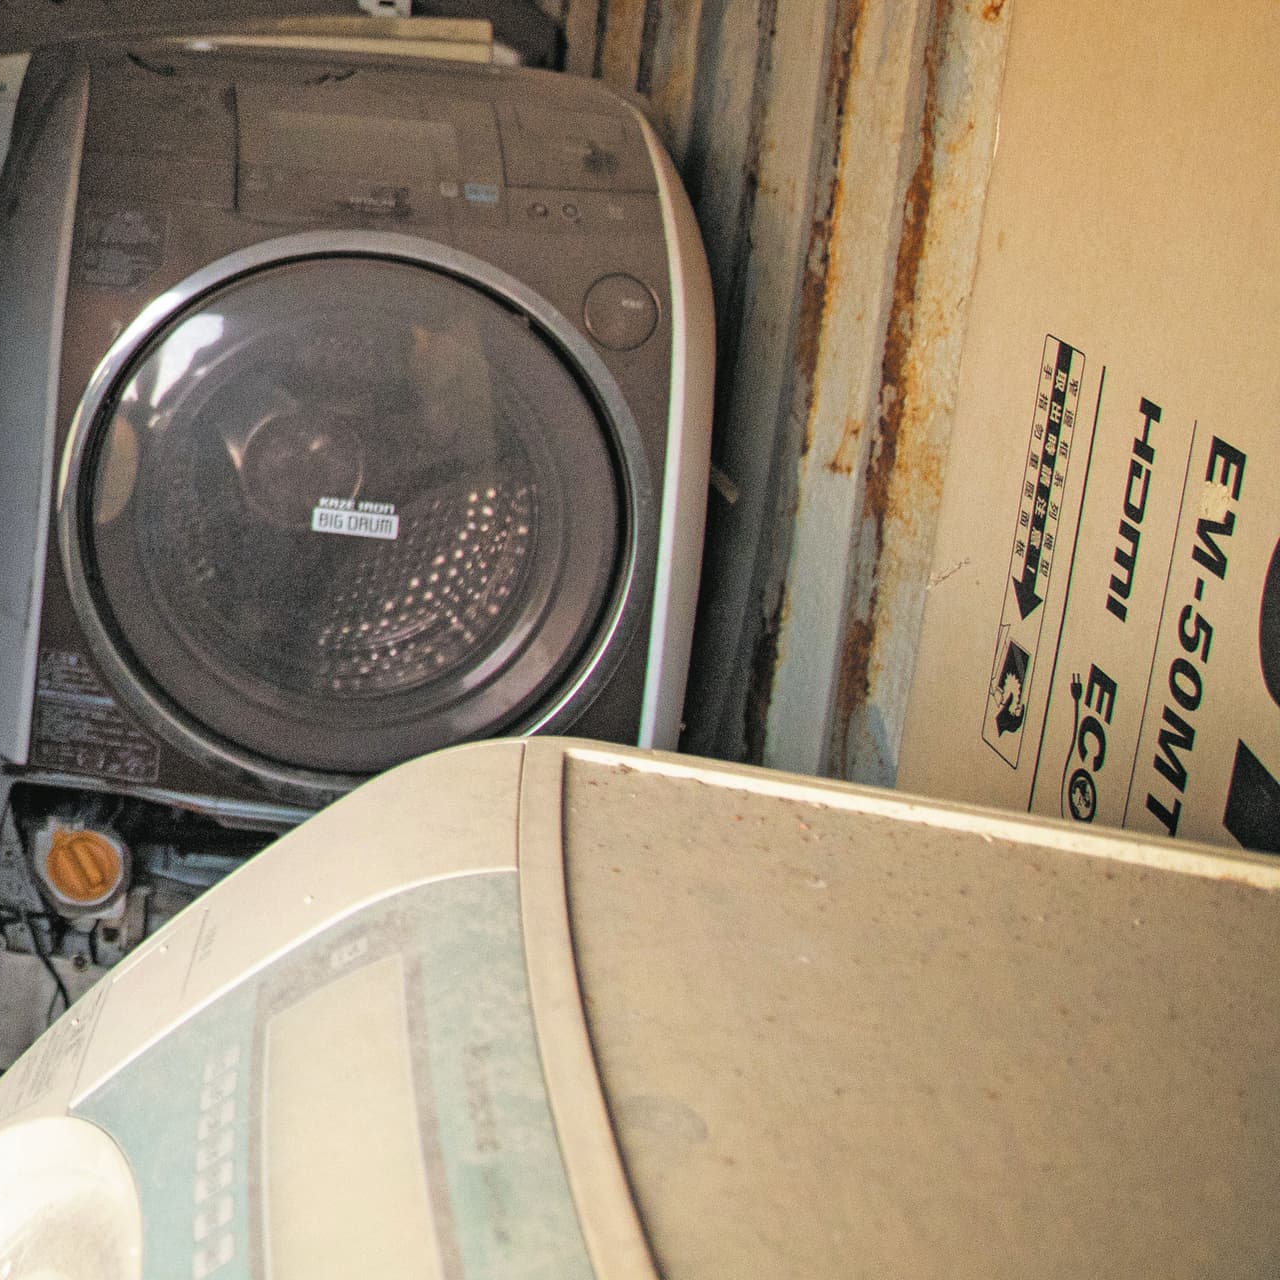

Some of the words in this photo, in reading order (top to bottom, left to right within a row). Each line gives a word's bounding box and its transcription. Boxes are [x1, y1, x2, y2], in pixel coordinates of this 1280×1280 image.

[319, 512, 343, 529] BIG
[348, 516, 393, 536] DRUM
[1105, 396, 1162, 622] HDMI
[1147, 435, 1247, 837] EM-50MT
